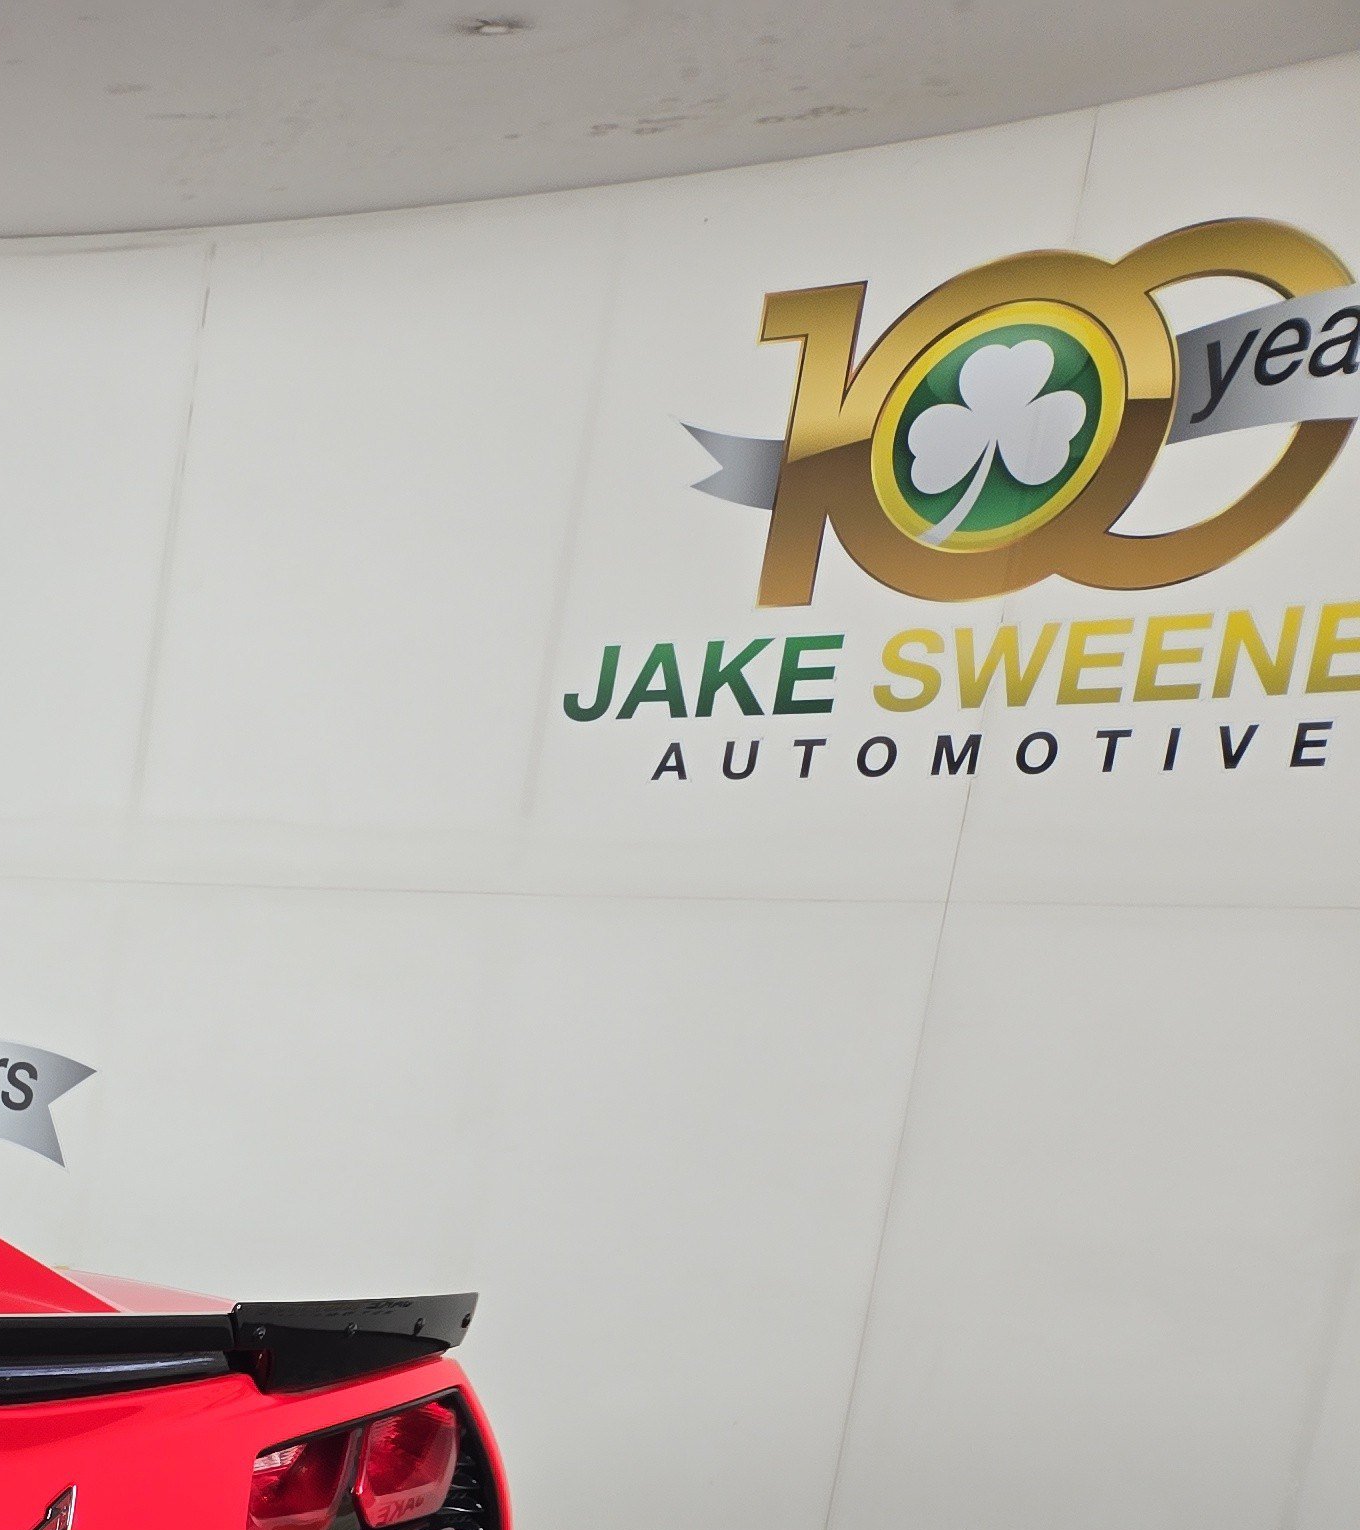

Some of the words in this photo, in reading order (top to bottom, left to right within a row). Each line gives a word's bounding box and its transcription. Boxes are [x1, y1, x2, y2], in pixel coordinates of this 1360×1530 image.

[756, 216, 1360, 609] 100
[563, 633, 845, 722] JAKE
[651, 720, 1333, 782] AUTOMOTIVE
